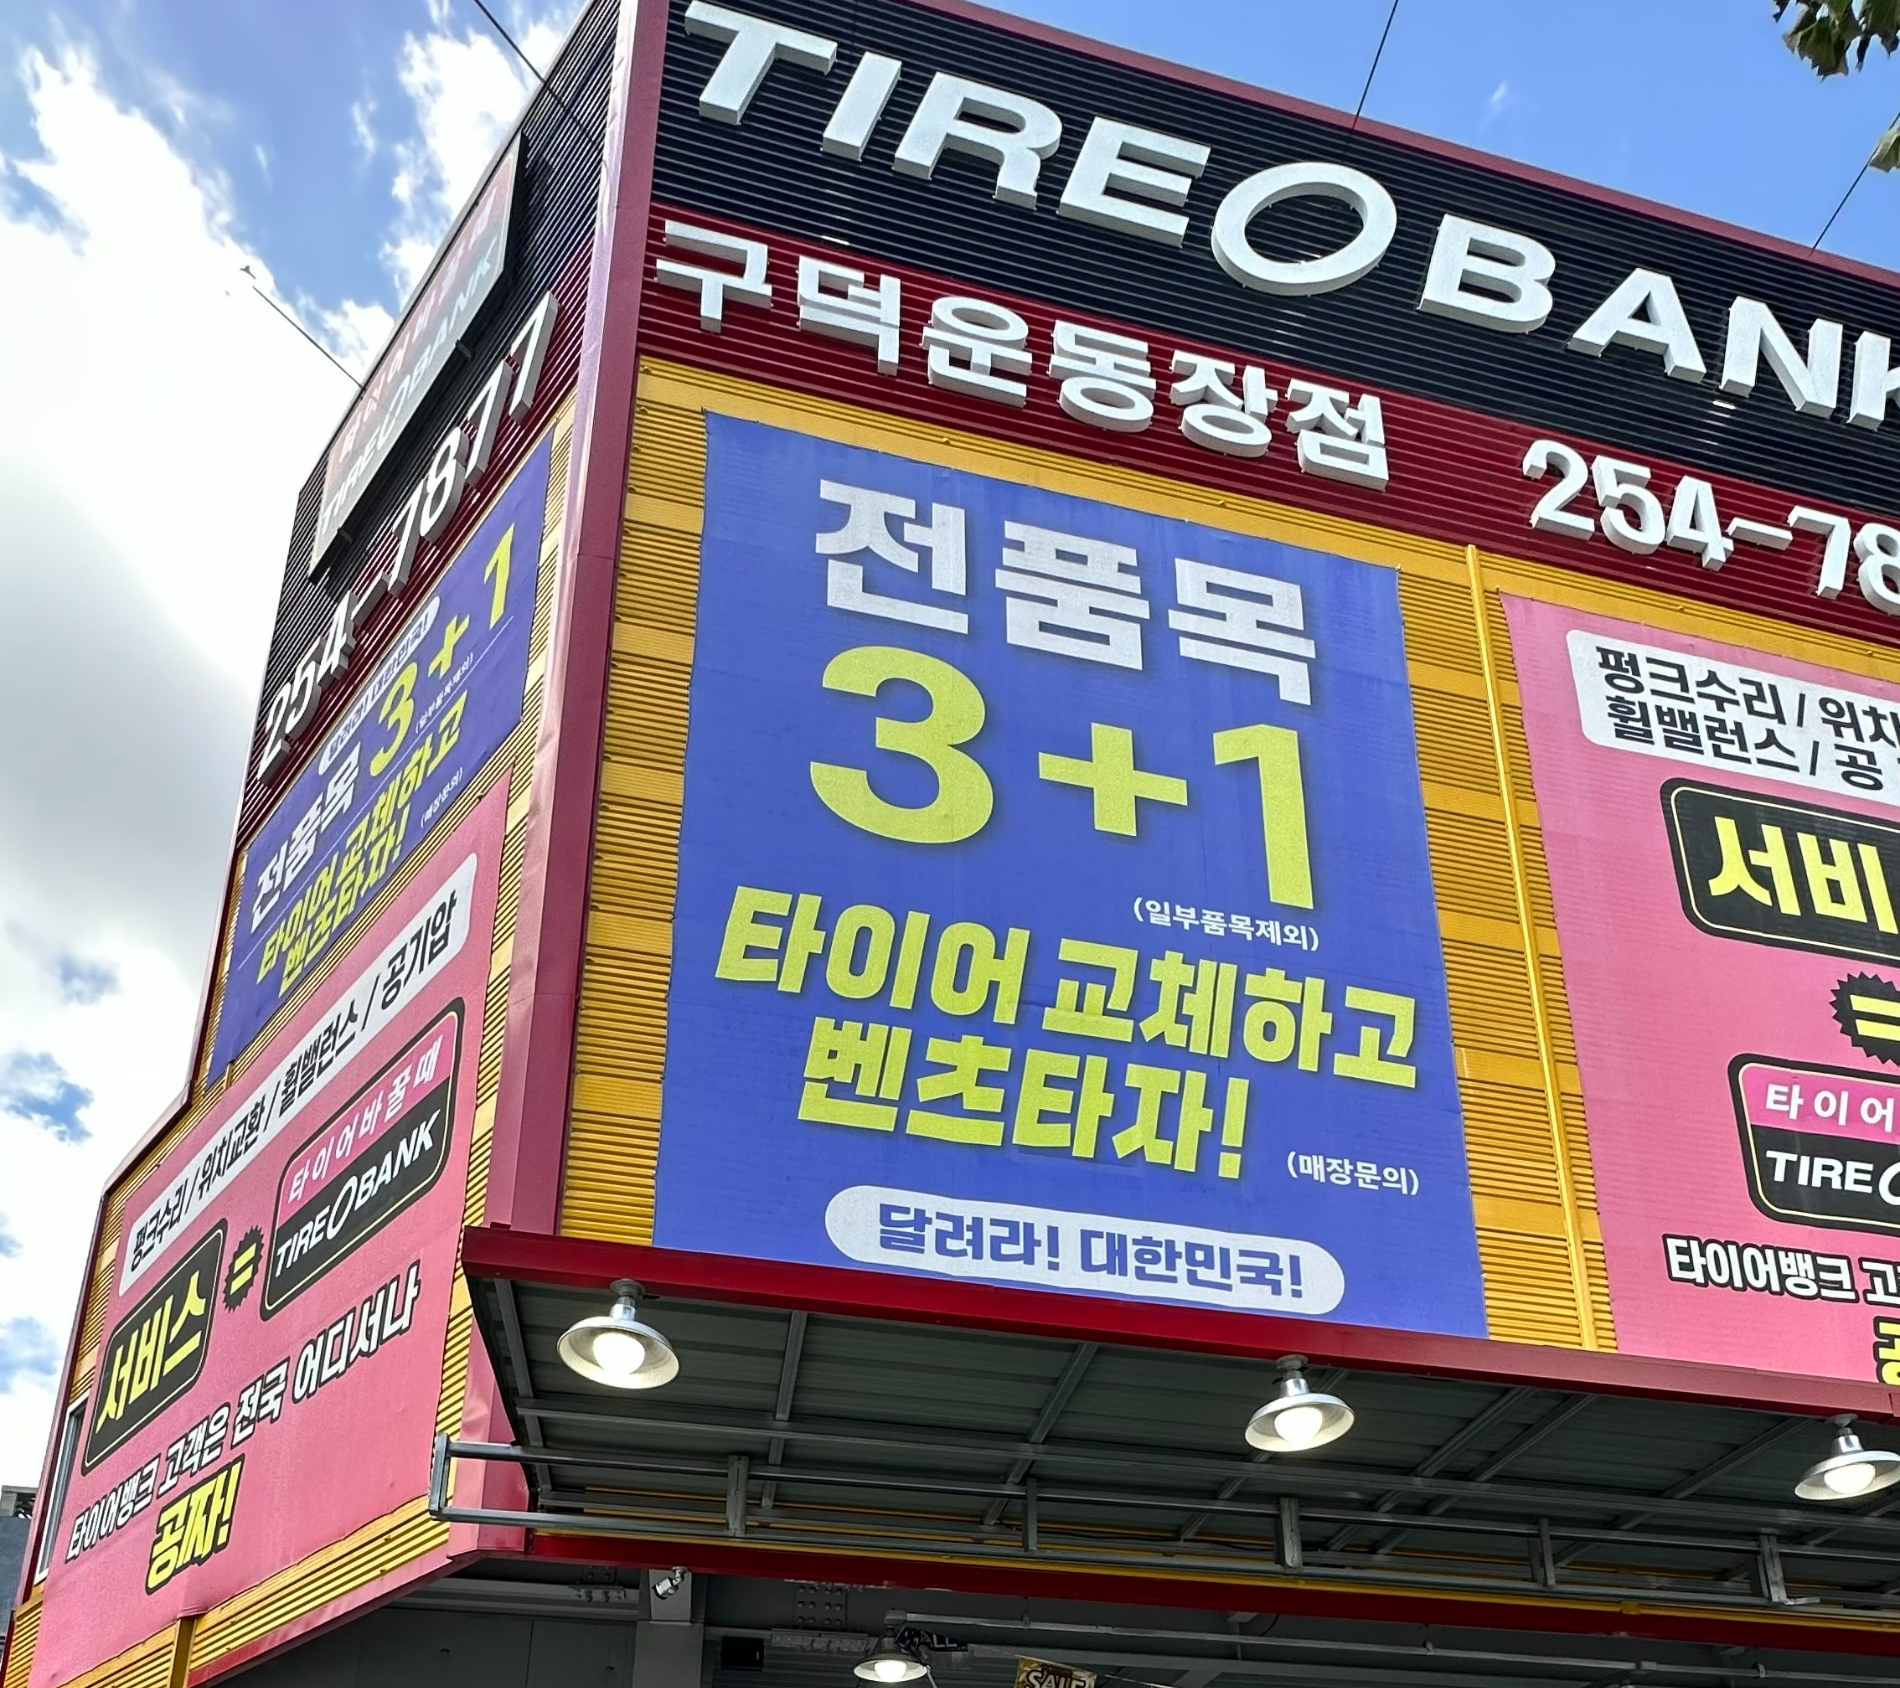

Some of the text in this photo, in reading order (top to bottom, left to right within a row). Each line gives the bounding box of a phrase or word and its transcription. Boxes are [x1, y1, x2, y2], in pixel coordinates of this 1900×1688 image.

[656, 218, 1391, 493] 구덕운동장점
[256, 290, 560, 785] 254-7877
[816, 480, 1318, 705] 전품목
[1596, 646, 1787, 726] 펑크수리
[1606, 695, 1800, 773] 휠밸런스
[251, 741, 361, 933] 전품목
[257, 689, 467, 985] 타이어 교체하고
[279, 803, 410, 998] 벤츠타자!
[1132, 896, 1322, 953] (일부품목제외)
[715, 885, 1416, 1090] 타이어 교체하고
[132, 890, 456, 1272] 펑크수리 위치교환 휠밸런스 공기압
[797, 1017, 1251, 1180] 벤츠타자!
[877, 1201, 1303, 1300] 달려라! 대한민국!
[1286, 1151, 1420, 1198] (매장문의)
[96, 1270, 206, 1434] 서비스
[1665, 1235, 1857, 1301] 타이어뱅크
[67, 1262, 420, 1561] 타이어뱅크 고객은 전국 어디서나
[148, 1458, 243, 1591] 공짜!
